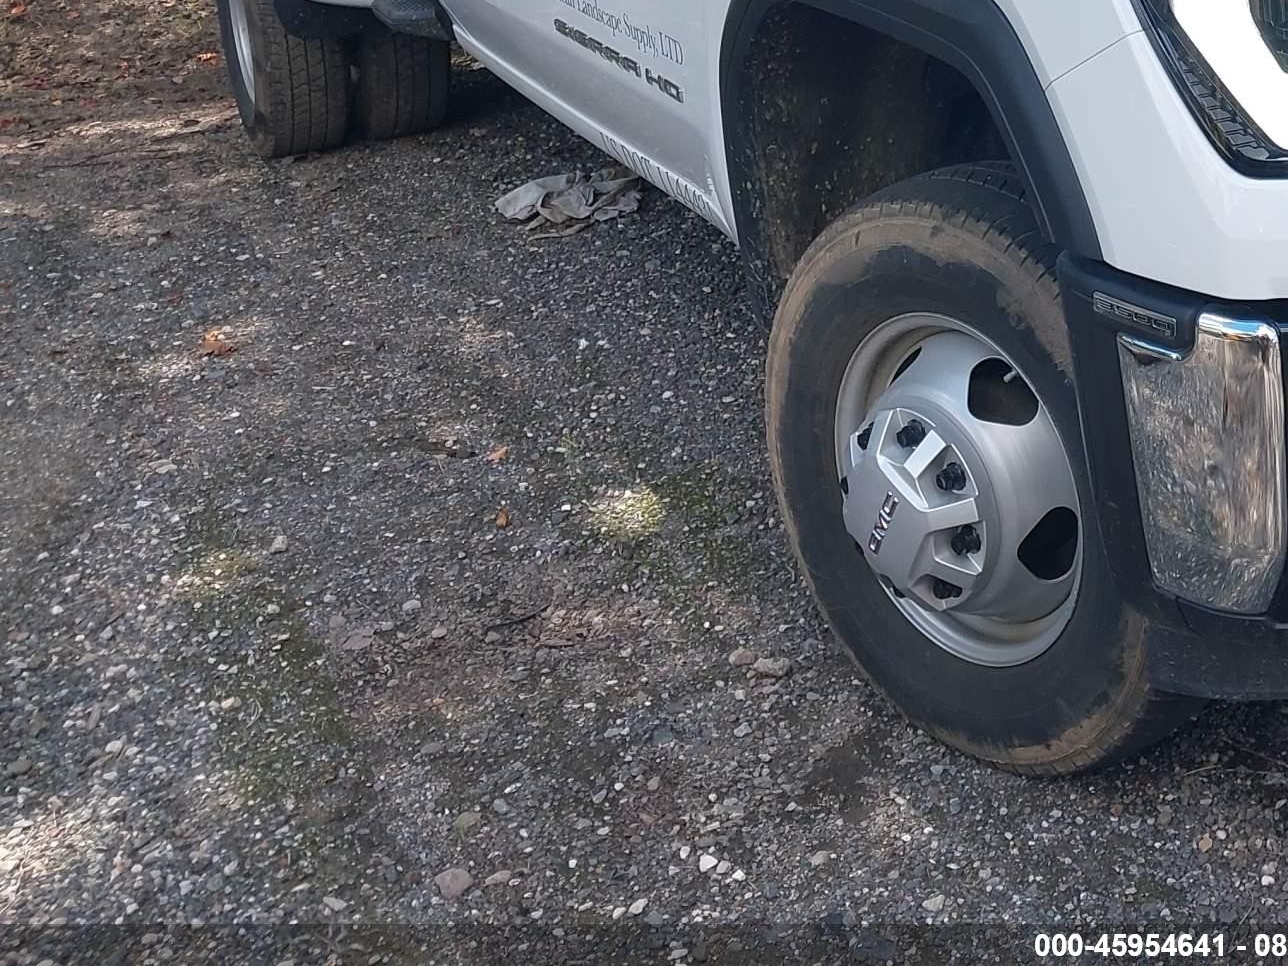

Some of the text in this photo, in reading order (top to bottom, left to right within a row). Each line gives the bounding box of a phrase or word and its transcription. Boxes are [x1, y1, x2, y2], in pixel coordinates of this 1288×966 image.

[554, 18, 684, 103] SIERRA HD
[623, 13, 659, 58] Supply,
[659, 32, 684, 66] LTD
[867, 490, 900, 556] GMC
